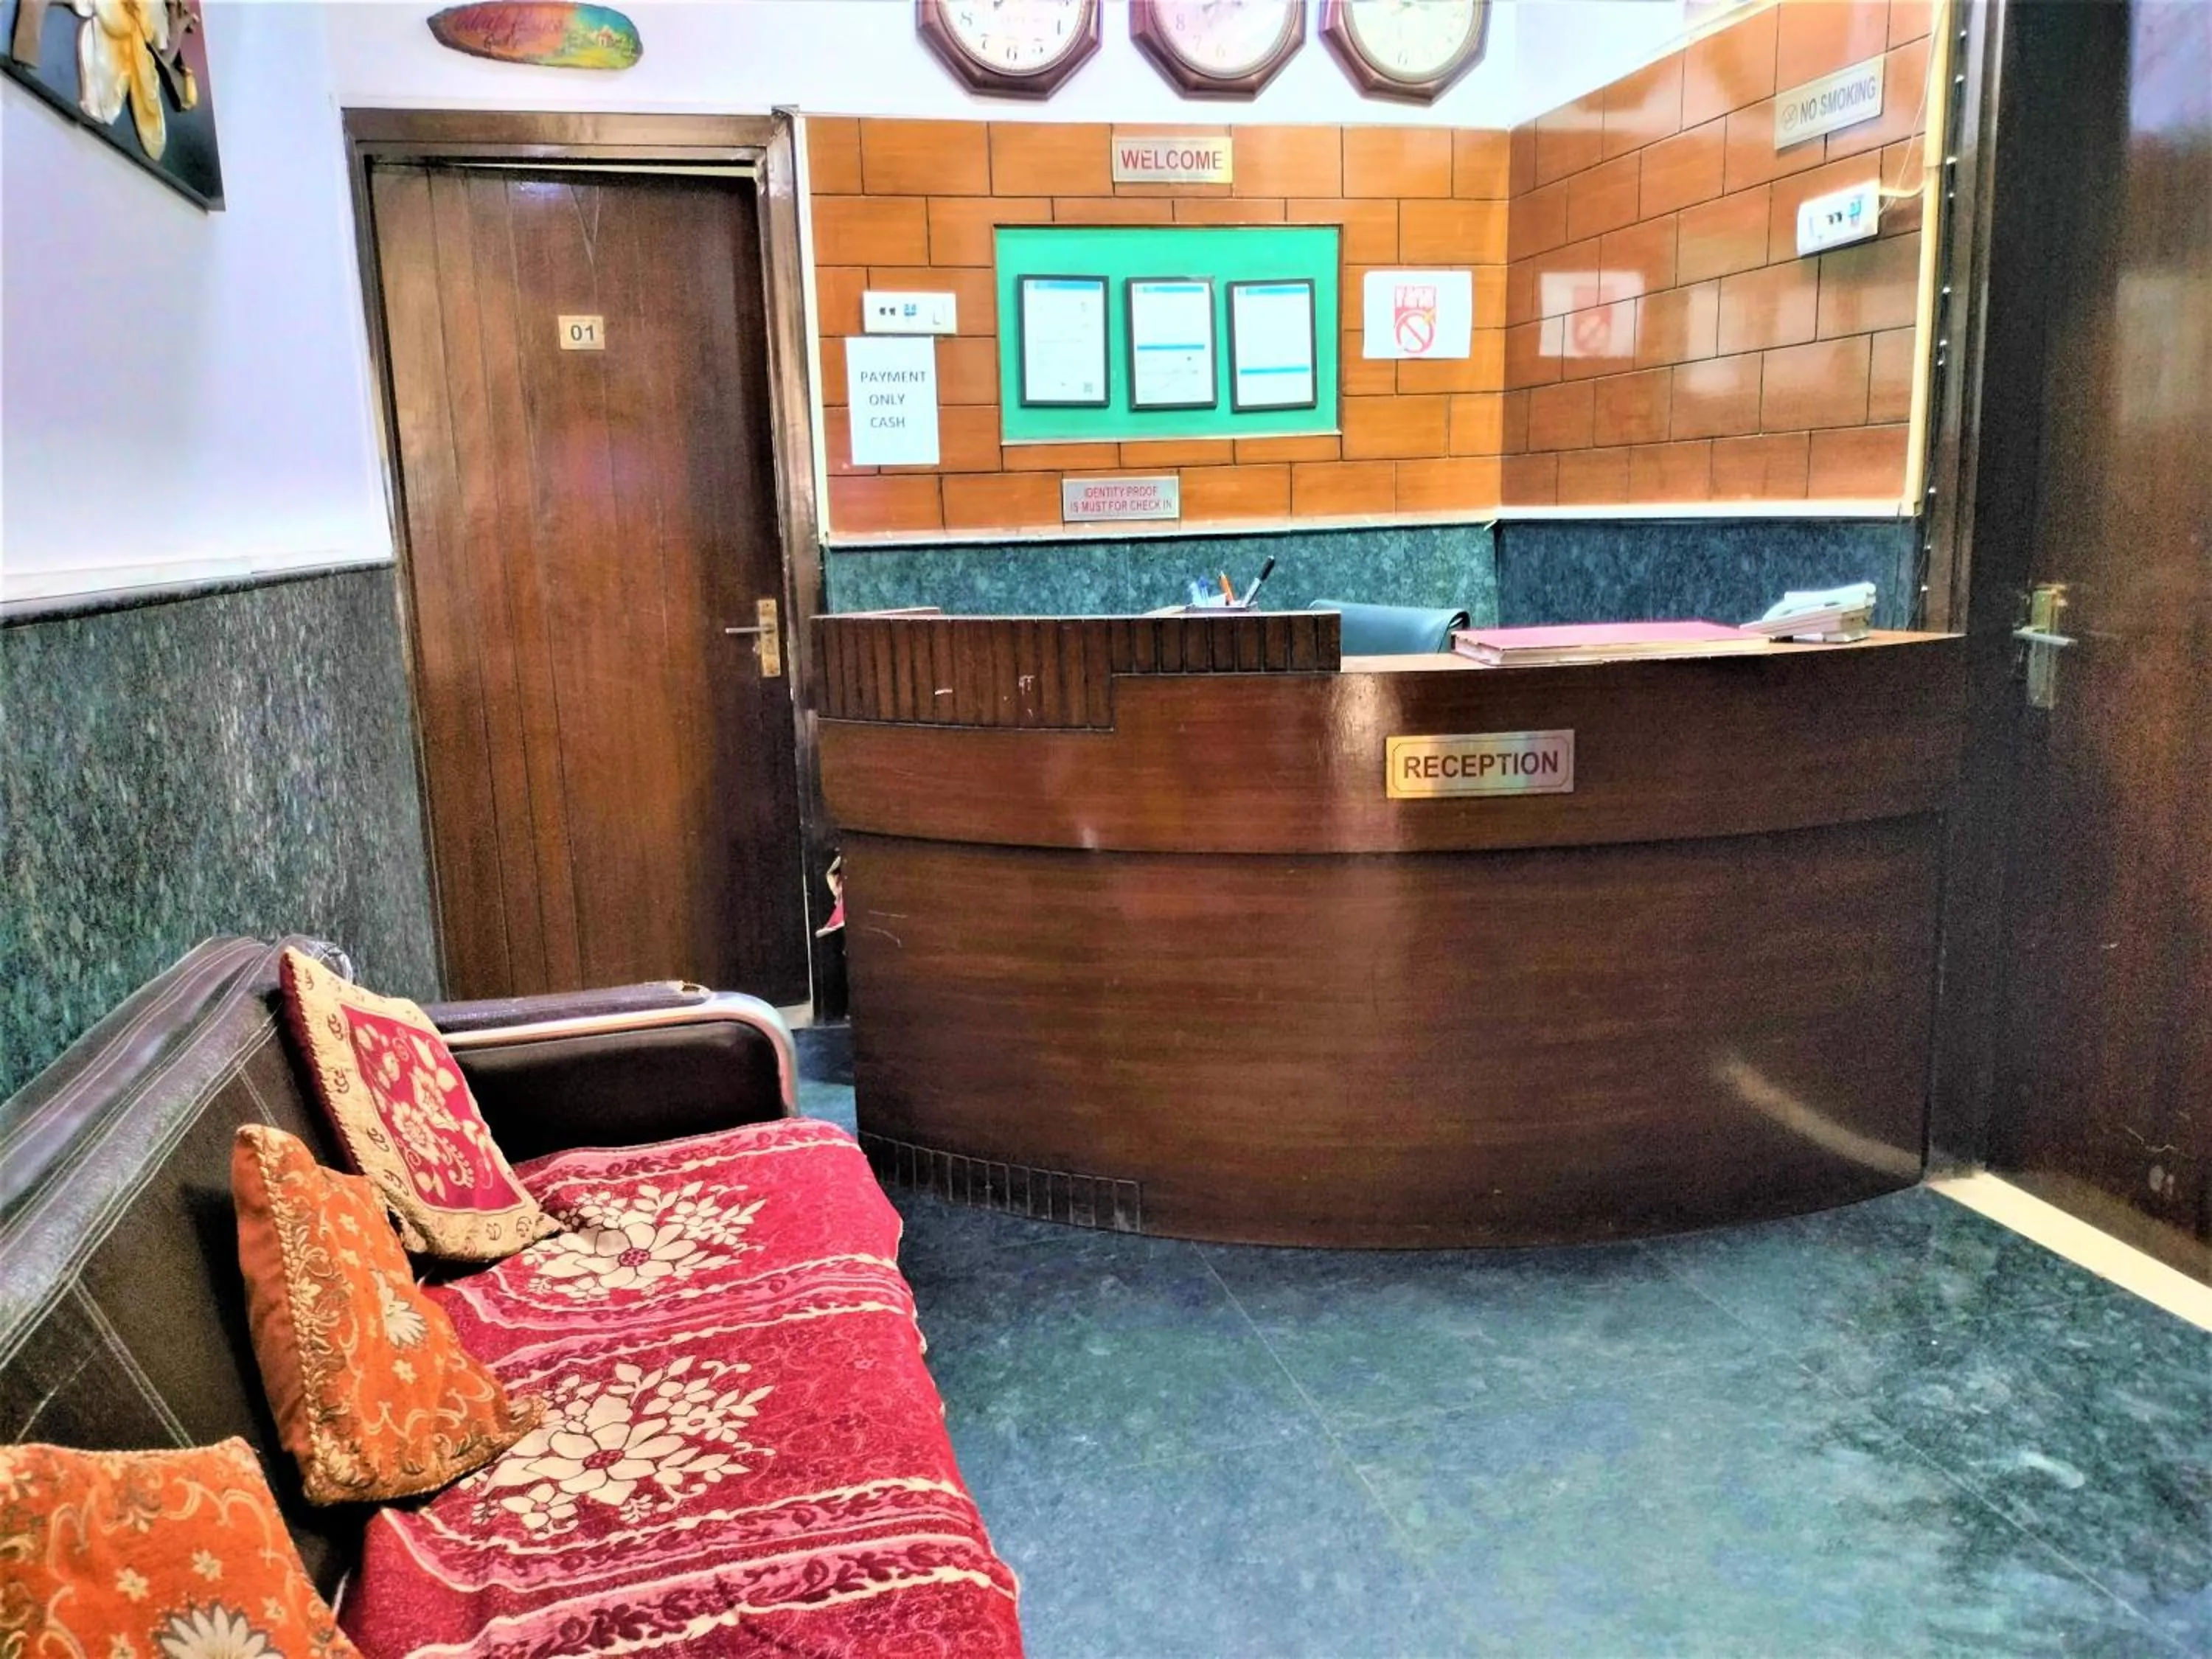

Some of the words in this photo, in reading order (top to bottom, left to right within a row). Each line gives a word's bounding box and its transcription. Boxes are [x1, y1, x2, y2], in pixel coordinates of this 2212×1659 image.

[1799, 98, 1818, 125] NO
[1819, 75, 1877, 118] SMOKING
[1120, 149, 1223, 170] WELCOME
[570, 324, 594, 341] 01
[860, 370, 927, 383] PAYMENT
[869, 393, 905, 406] ONLY
[870, 417, 905, 428] CASH
[1085, 487, 1124, 498] IDENTITY
[1126, 485, 1158, 497] PROOF
[1070, 502, 1079, 512] IS
[1081, 501, 1107, 512] MUST
[1108, 500, 1127, 511] FOR
[1129, 498, 1161, 511] CHECK
[1163, 498, 1172, 509] IN
[1402, 750, 1559, 779] RECEPTION
